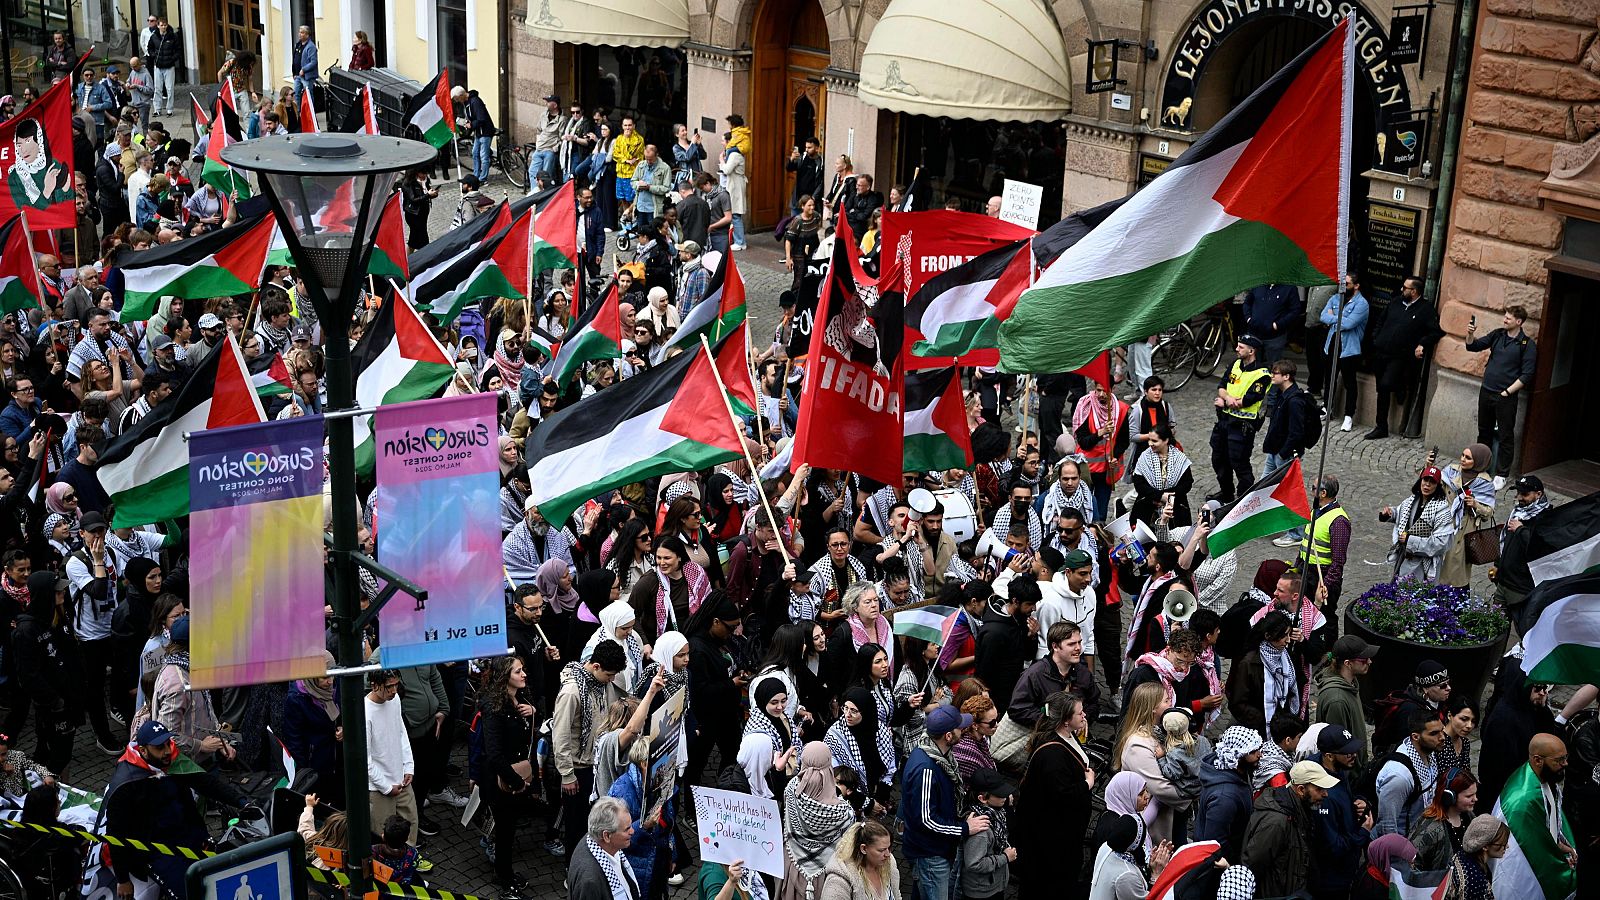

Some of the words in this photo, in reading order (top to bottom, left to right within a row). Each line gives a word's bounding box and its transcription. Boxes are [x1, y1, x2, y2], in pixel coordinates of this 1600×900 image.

[1160, 143, 1166, 153] 8
[1009, 184, 1032, 195] ZERO
[1395, 189, 1401, 199] 8
[1009, 194, 1034, 206] POINTS
[1012, 203, 1024, 212] FOR
[1002, 211, 1034, 224] GENOCIDE
[921, 255, 966, 273] FROM
[820, 355, 900, 424] IFADA
[703, 795, 722, 810] The
[723, 798, 745, 814] World
[746, 802, 759, 817] has
[760, 805, 772, 820] the
[716, 810, 732, 824] right
[734, 813, 741, 824] to
[742, 815, 767, 831] defend
[715, 821, 758, 844] Palestine
